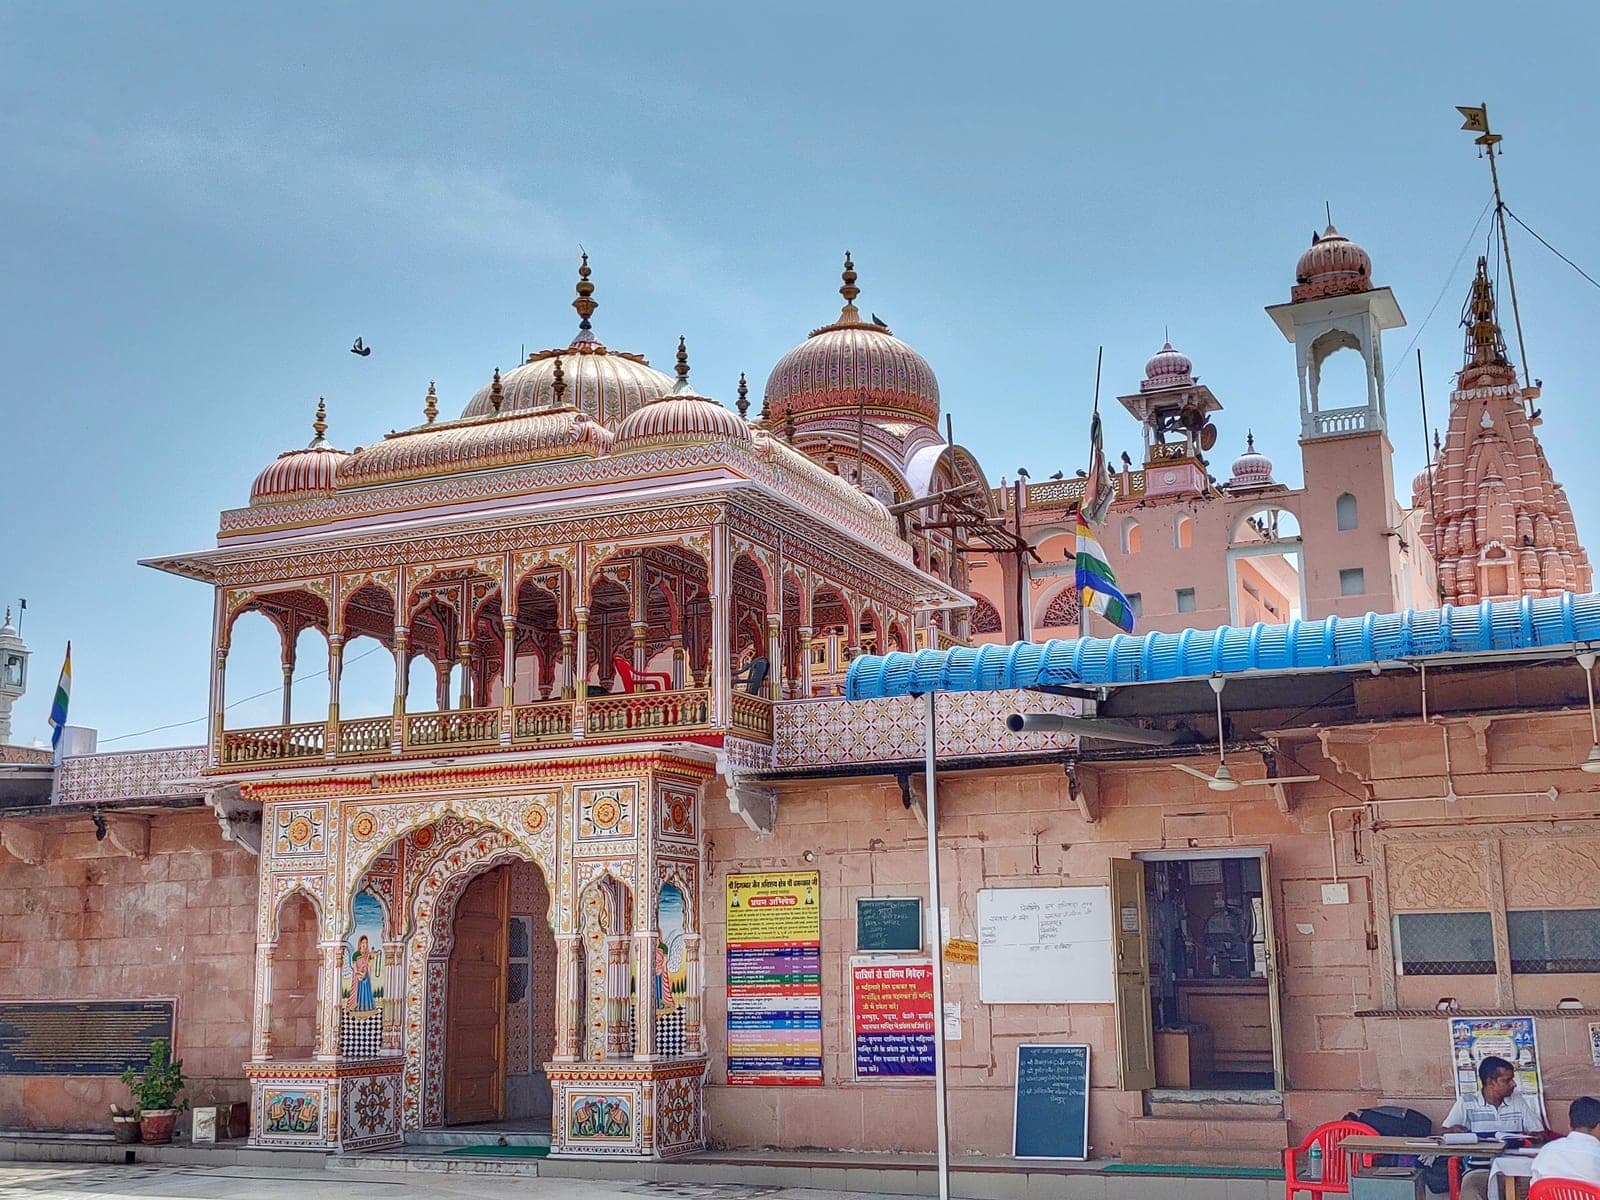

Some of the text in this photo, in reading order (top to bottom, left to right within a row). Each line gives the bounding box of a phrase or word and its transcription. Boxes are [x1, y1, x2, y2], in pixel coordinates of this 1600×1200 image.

[761, 879, 777, 888] अतिशय
[769, 896, 796, 905] अभिषेक
[855, 968, 874, 979] यात्रियों
[876, 969, 882, 979] से
[883, 968, 904, 979] सविनय
[905, 968, 925, 979] निवेदन
